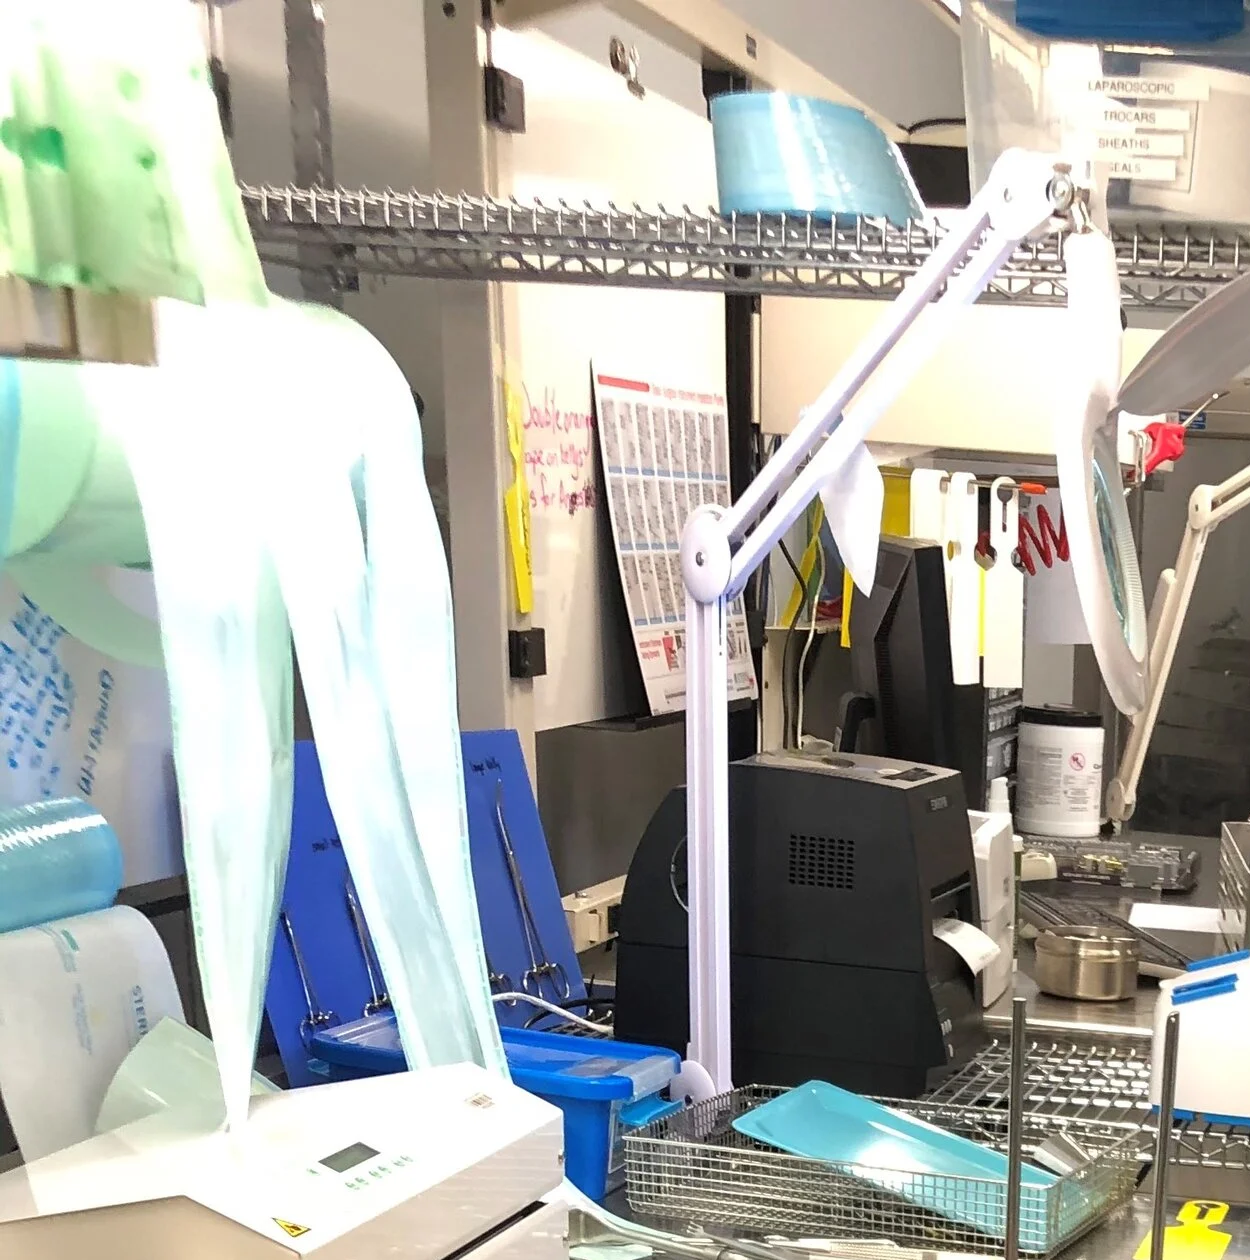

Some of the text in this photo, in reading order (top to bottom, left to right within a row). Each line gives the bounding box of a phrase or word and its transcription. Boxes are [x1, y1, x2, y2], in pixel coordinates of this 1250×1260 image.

[1088, 80, 1175, 95] LAPAROSCOPIC
[1104, 110, 1156, 124] TROCARS
[1098, 138, 1150, 150] SHEATHS
